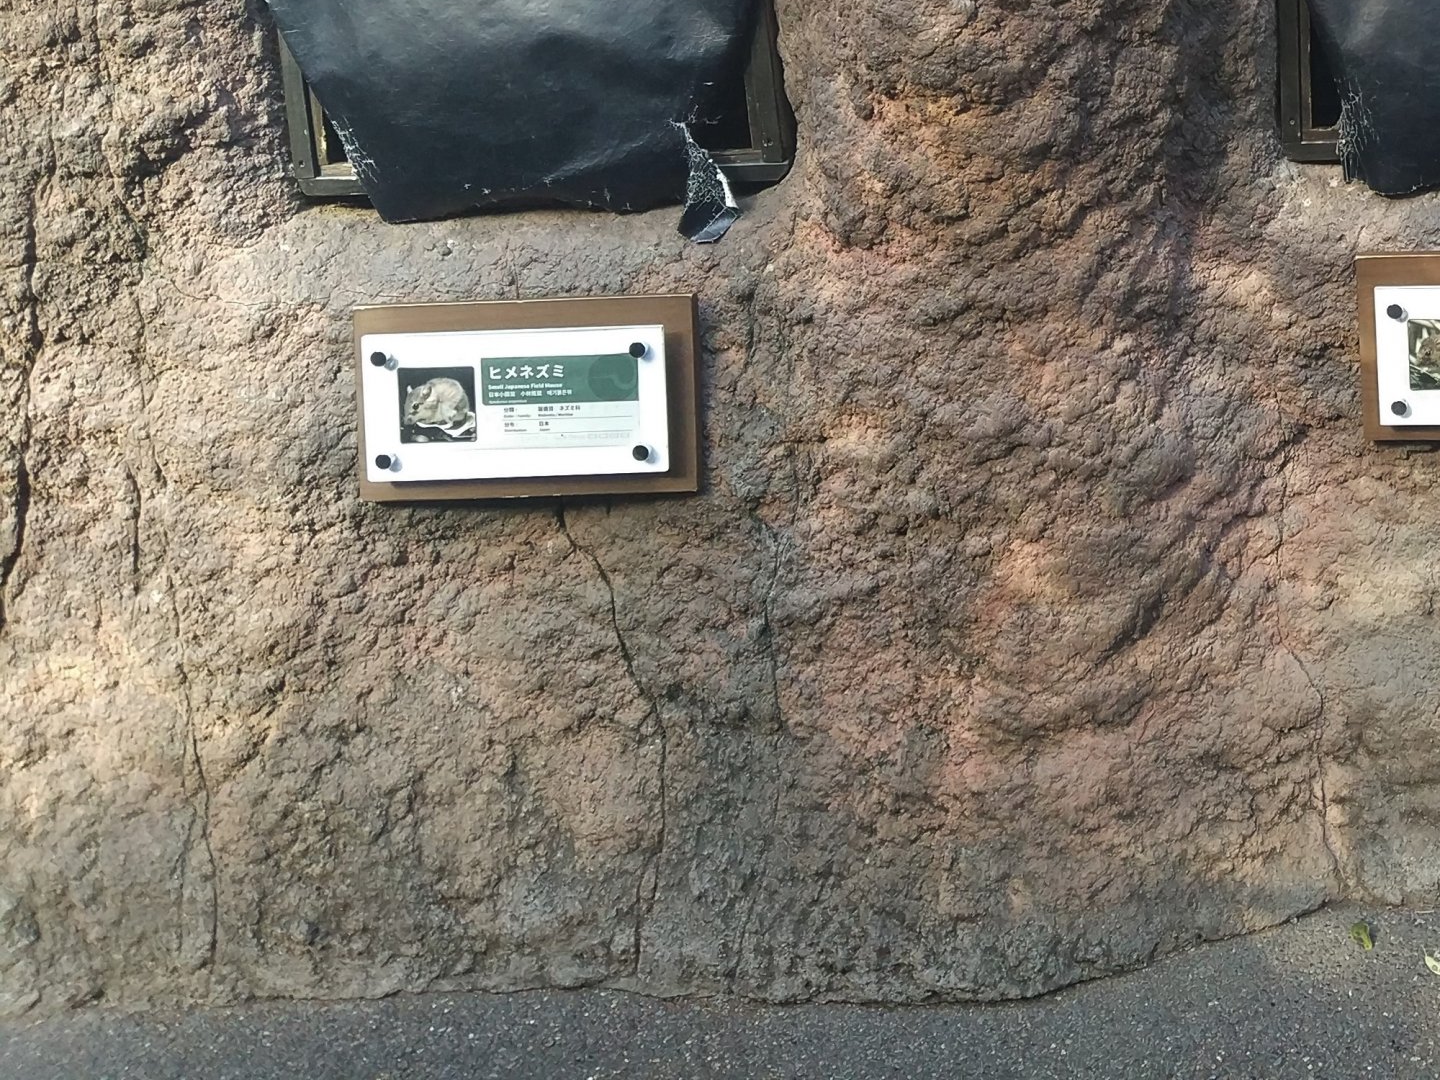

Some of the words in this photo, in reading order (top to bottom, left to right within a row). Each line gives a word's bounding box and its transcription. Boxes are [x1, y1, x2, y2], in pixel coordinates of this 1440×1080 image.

[489, 364, 564, 380] ヒメネズミ
